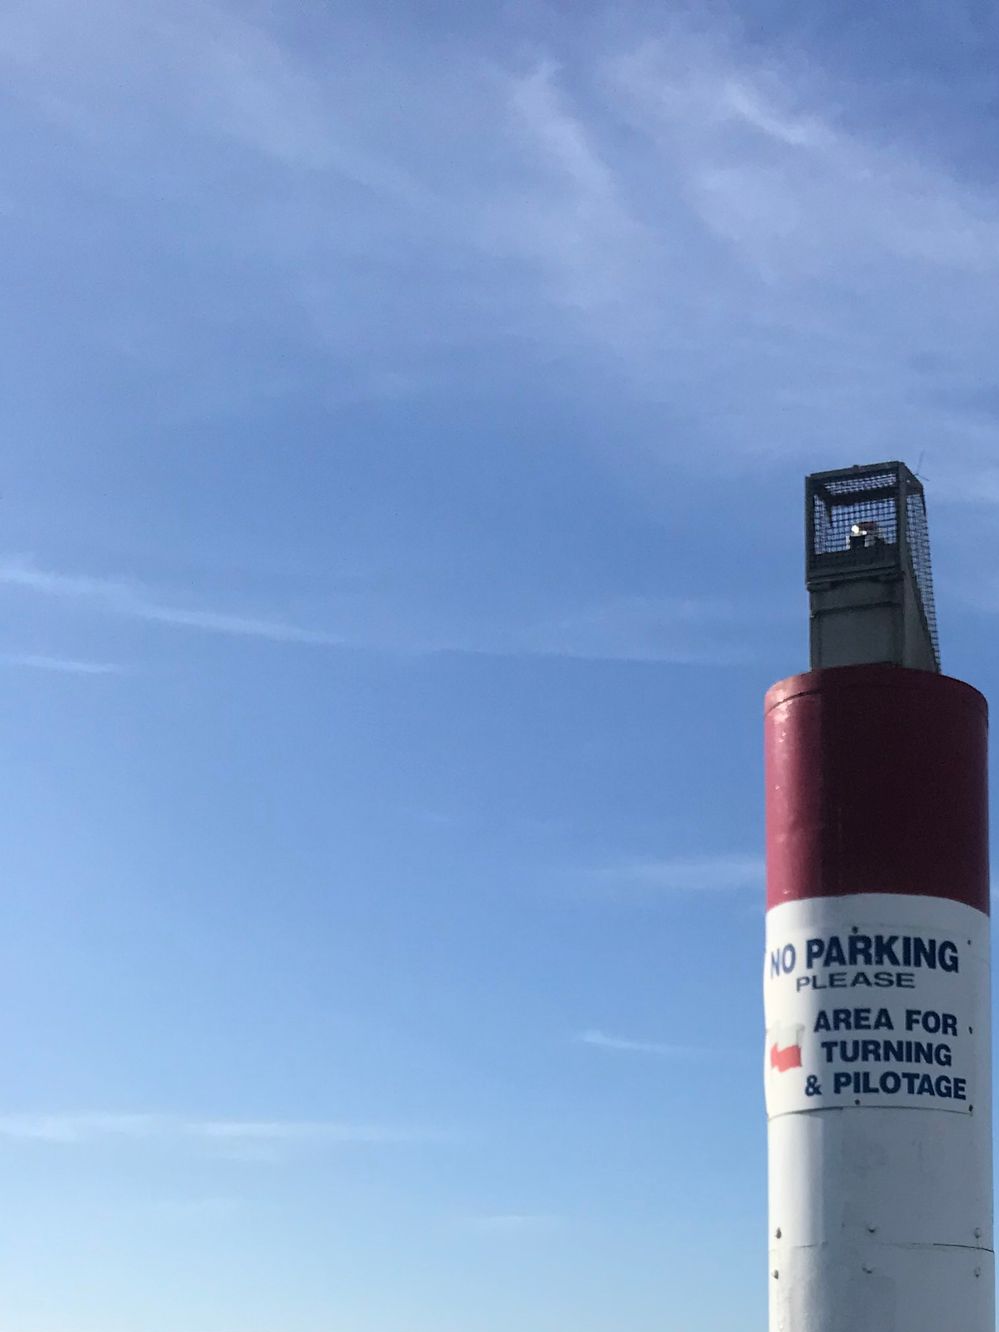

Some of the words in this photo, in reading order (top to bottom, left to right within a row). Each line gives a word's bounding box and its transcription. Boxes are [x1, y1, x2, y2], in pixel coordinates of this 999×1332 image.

[771, 943, 796, 979] NO
[806, 935, 959, 973] PARKING
[796, 971, 916, 992] PLEASE
[814, 1008, 894, 1033] AREA
[905, 1009, 958, 1036] FOR
[821, 1040, 952, 1067] TURNING
[805, 1074, 822, 1096] &
[833, 1071, 967, 1100] PILOTAGE
